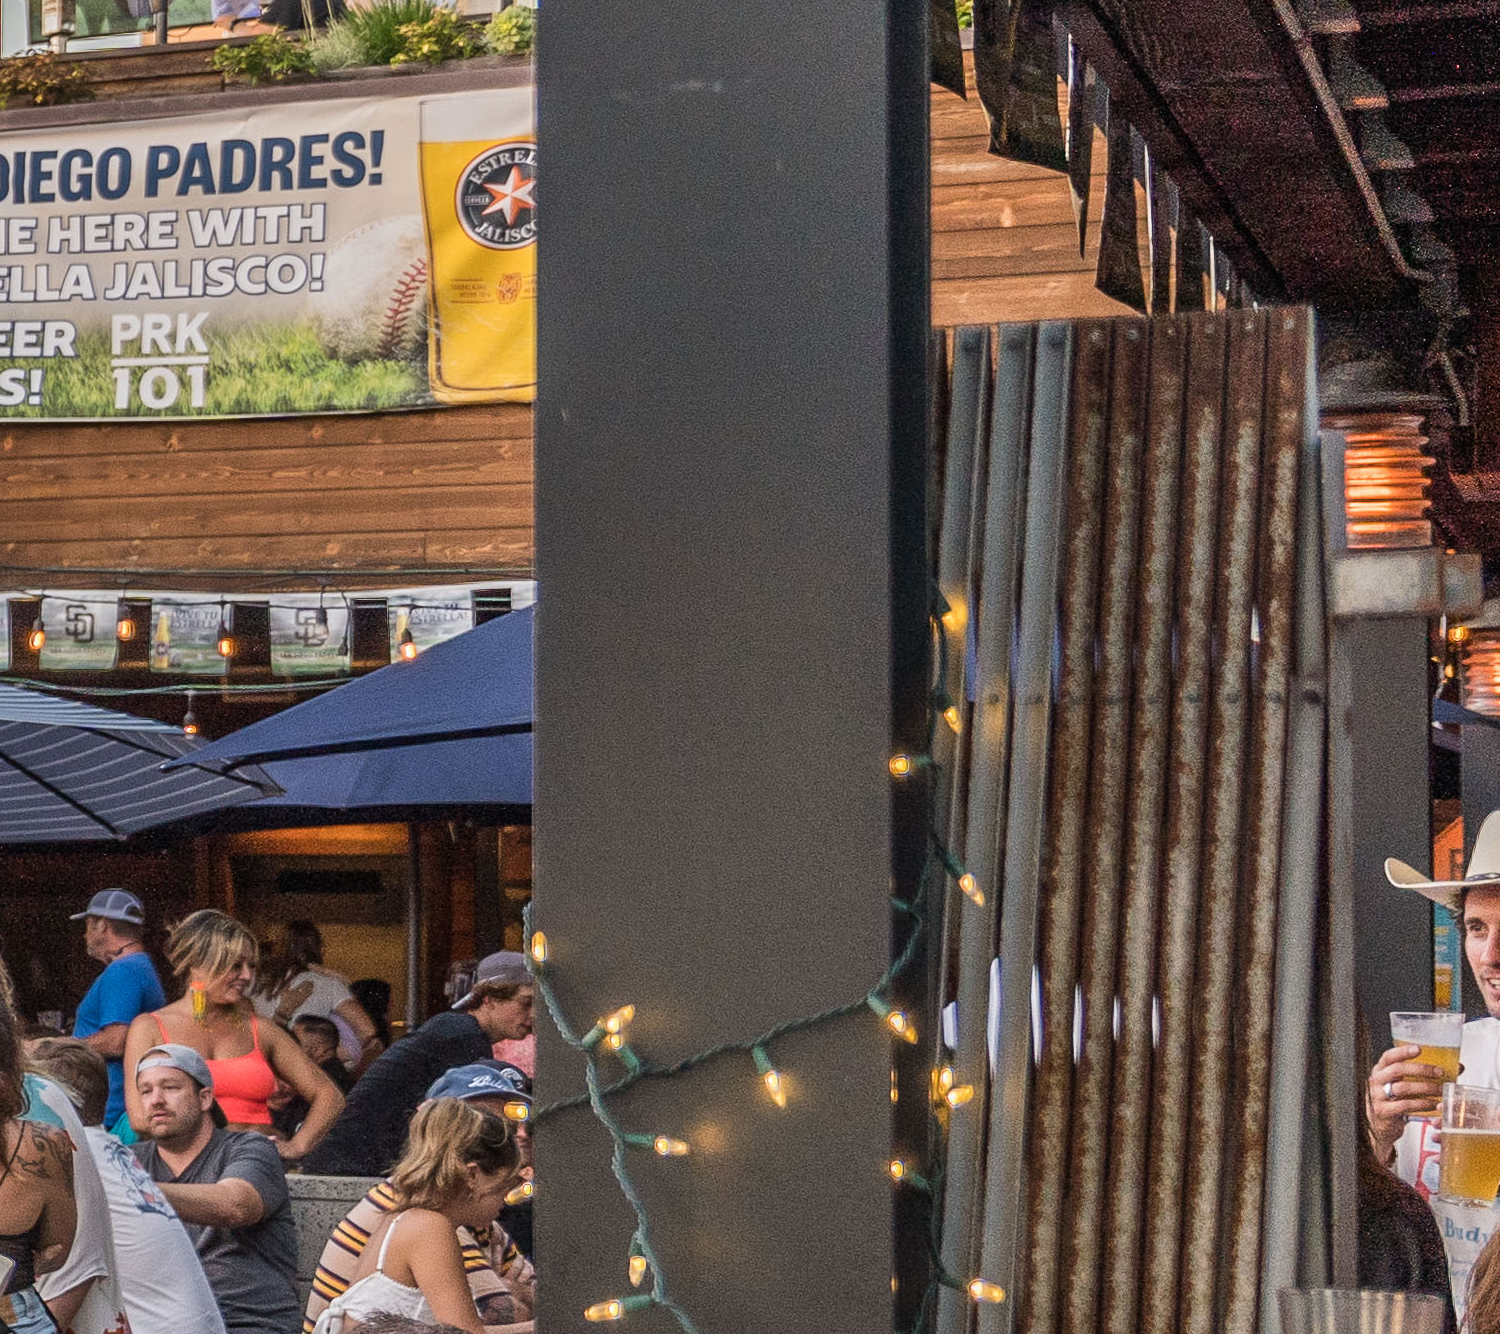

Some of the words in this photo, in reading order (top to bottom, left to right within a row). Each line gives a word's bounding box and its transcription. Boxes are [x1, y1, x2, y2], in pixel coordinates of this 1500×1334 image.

[144, 129, 385, 198] PADRES!
[469, 149, 537, 185] ESTREL
[46, 210, 179, 254] HERE
[187, 202, 327, 248] WITH
[104, 252, 326, 301] JALISCO!
[111, 311, 210, 356] PRK
[112, 367, 208, 411] 101
